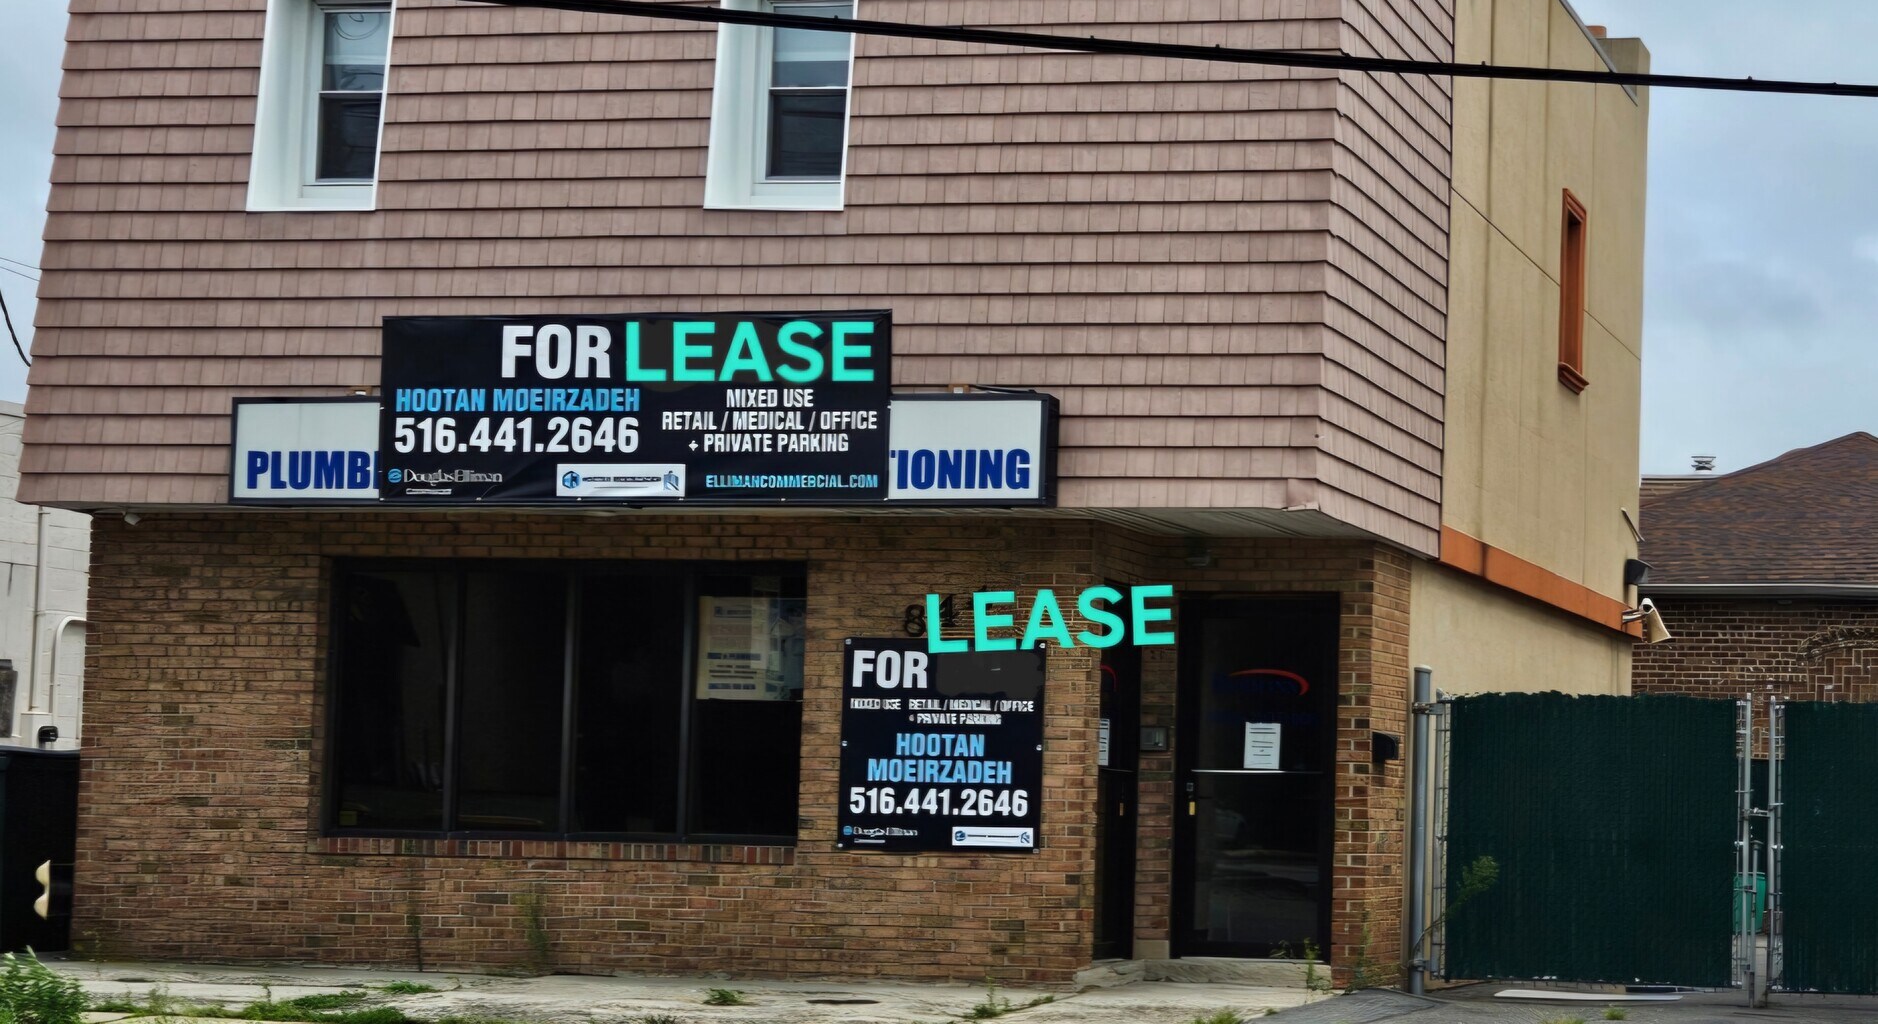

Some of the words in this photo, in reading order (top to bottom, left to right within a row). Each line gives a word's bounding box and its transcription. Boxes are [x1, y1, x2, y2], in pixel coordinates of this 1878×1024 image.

[501, 324, 612, 379] FOR
[395, 388, 486, 412] HOOTAN
[493, 388, 640, 412] MOEIRZADEH
[726, 389, 778, 408] MIXED
[783, 389, 814, 408] USE
[662, 411, 717, 430] RETAIL
[732, 411, 804, 430] MEDICAL
[820, 410, 878, 430] OFFICE
[394, 416, 640, 454] 516.441.2646
[704, 433, 772, 452] PRIVATE
[777, 433, 849, 453] PARKING
[890, 448, 1030, 490] IONING
[852, 649, 928, 689] FOR
[896, 733, 985, 757] HOOTAN
[867, 759, 1012, 784] MOEIRZADEH
[849, 787, 1029, 817] 516.441.2646
